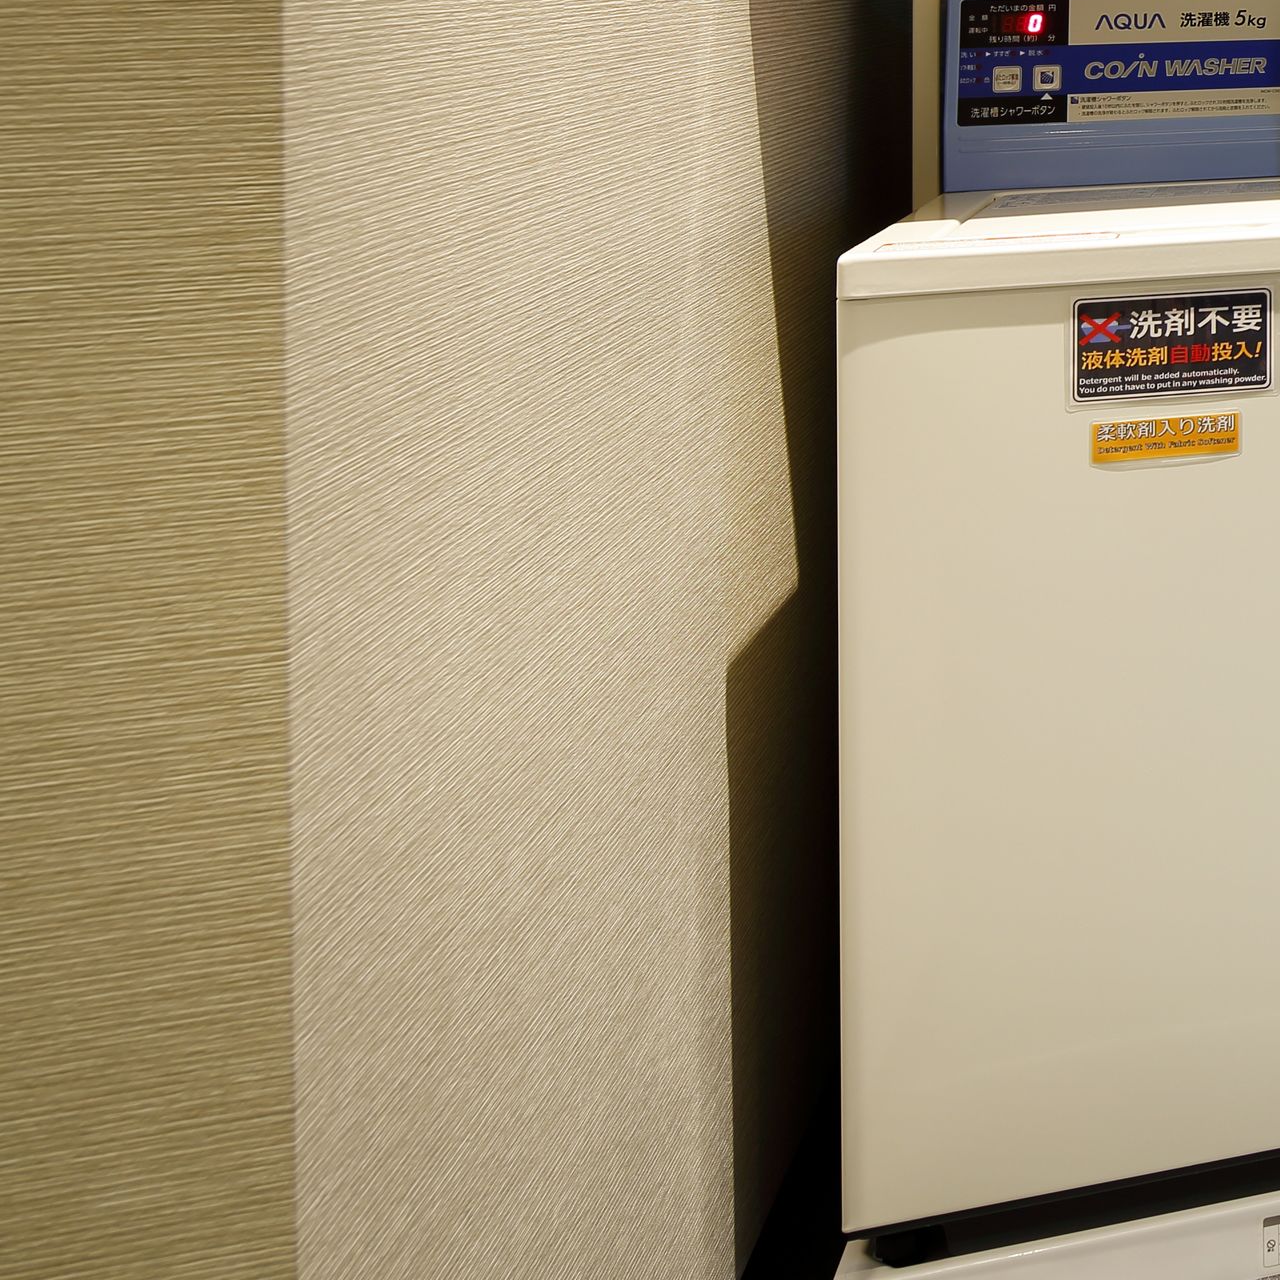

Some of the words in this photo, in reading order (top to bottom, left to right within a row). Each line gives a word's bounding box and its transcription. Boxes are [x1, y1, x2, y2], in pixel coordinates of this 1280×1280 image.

[990, 4, 1044, 12] ただいまの金額
[1027, 14, 1043, 33] 0
[1095, 13, 1166, 31] AQUA
[1180, 11, 1230, 28] 洗濯機
[1234, 10, 1267, 29] 5kg
[1165, 57, 1267, 78] WASHER
[970, 105, 1056, 118] 洗濯槽シャワーボタン
[1129, 304, 1263, 340] 洗剤不要
[1081, 341, 1263, 370] 液体洗剤自動投入!
[1079, 376, 1122, 386] Detergent
[1124, 374, 1139, 382] will
[1141, 373, 1152, 381] be
[1154, 371, 1180, 380] added
[1182, 368, 1240, 378] automatically.
[1079, 386, 1095, 394] You
[1096, 385, 1107, 393] do
[1109, 384, 1123, 392] not
[1125, 383, 1146, 391] have
[1147, 382, 1155, 390] to
[1157, 381, 1171, 389] put
[1182, 379, 1197, 388] any
[1199, 377, 1233, 386] washing
[1234, 374, 1267, 384] powder.
[1097, 414, 1235, 442] 柔軟剤入り洗剤
